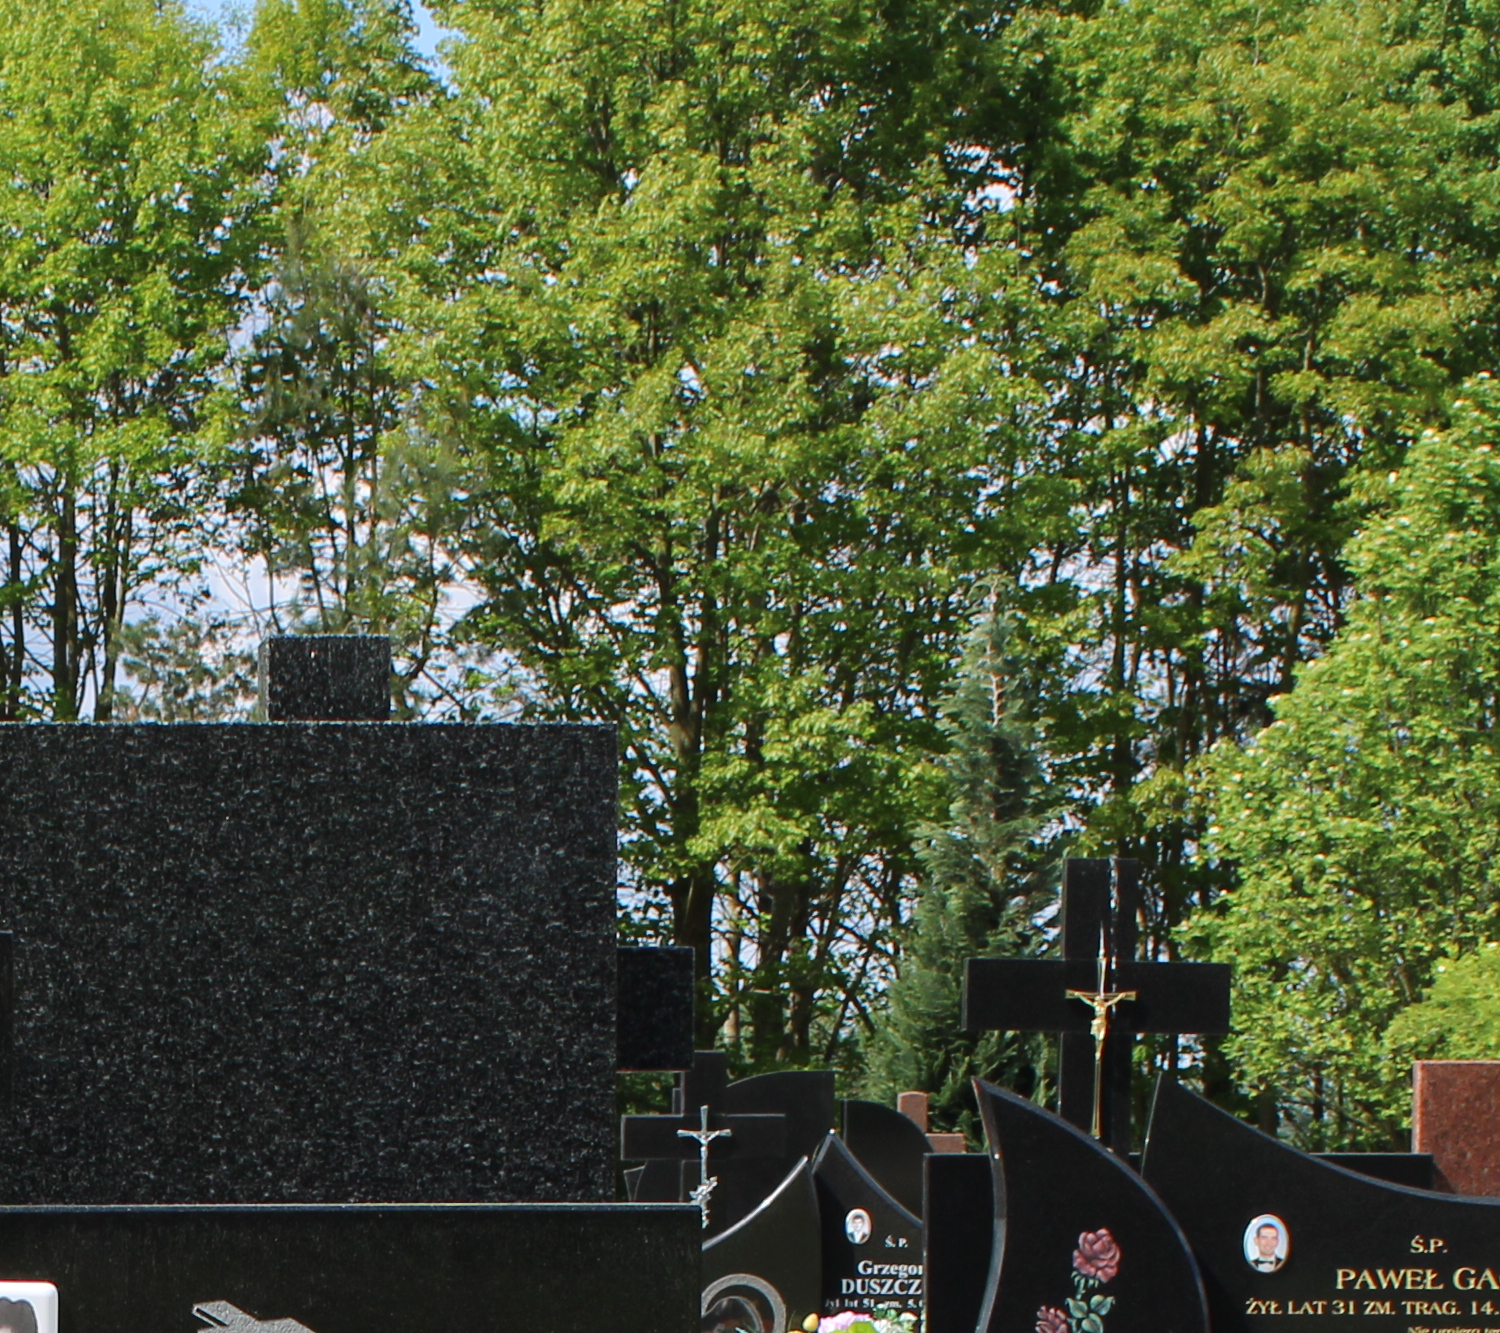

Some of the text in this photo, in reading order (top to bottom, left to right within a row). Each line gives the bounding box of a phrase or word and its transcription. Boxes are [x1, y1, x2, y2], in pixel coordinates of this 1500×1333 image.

[1410, 1234, 1448, 1254] Ś.P.
[1335, 1268, 1444, 1290] PAWEŁ
[844, 1298, 859, 1308] lat
[1245, 1297, 1283, 1316] ŻYŁ
[1288, 1300, 1328, 1316] LAT
[1332, 1300, 1355, 1316] 31
[1363, 1300, 1396, 1316] ZM.
[1401, 1300, 1462, 1316] TRAG.
